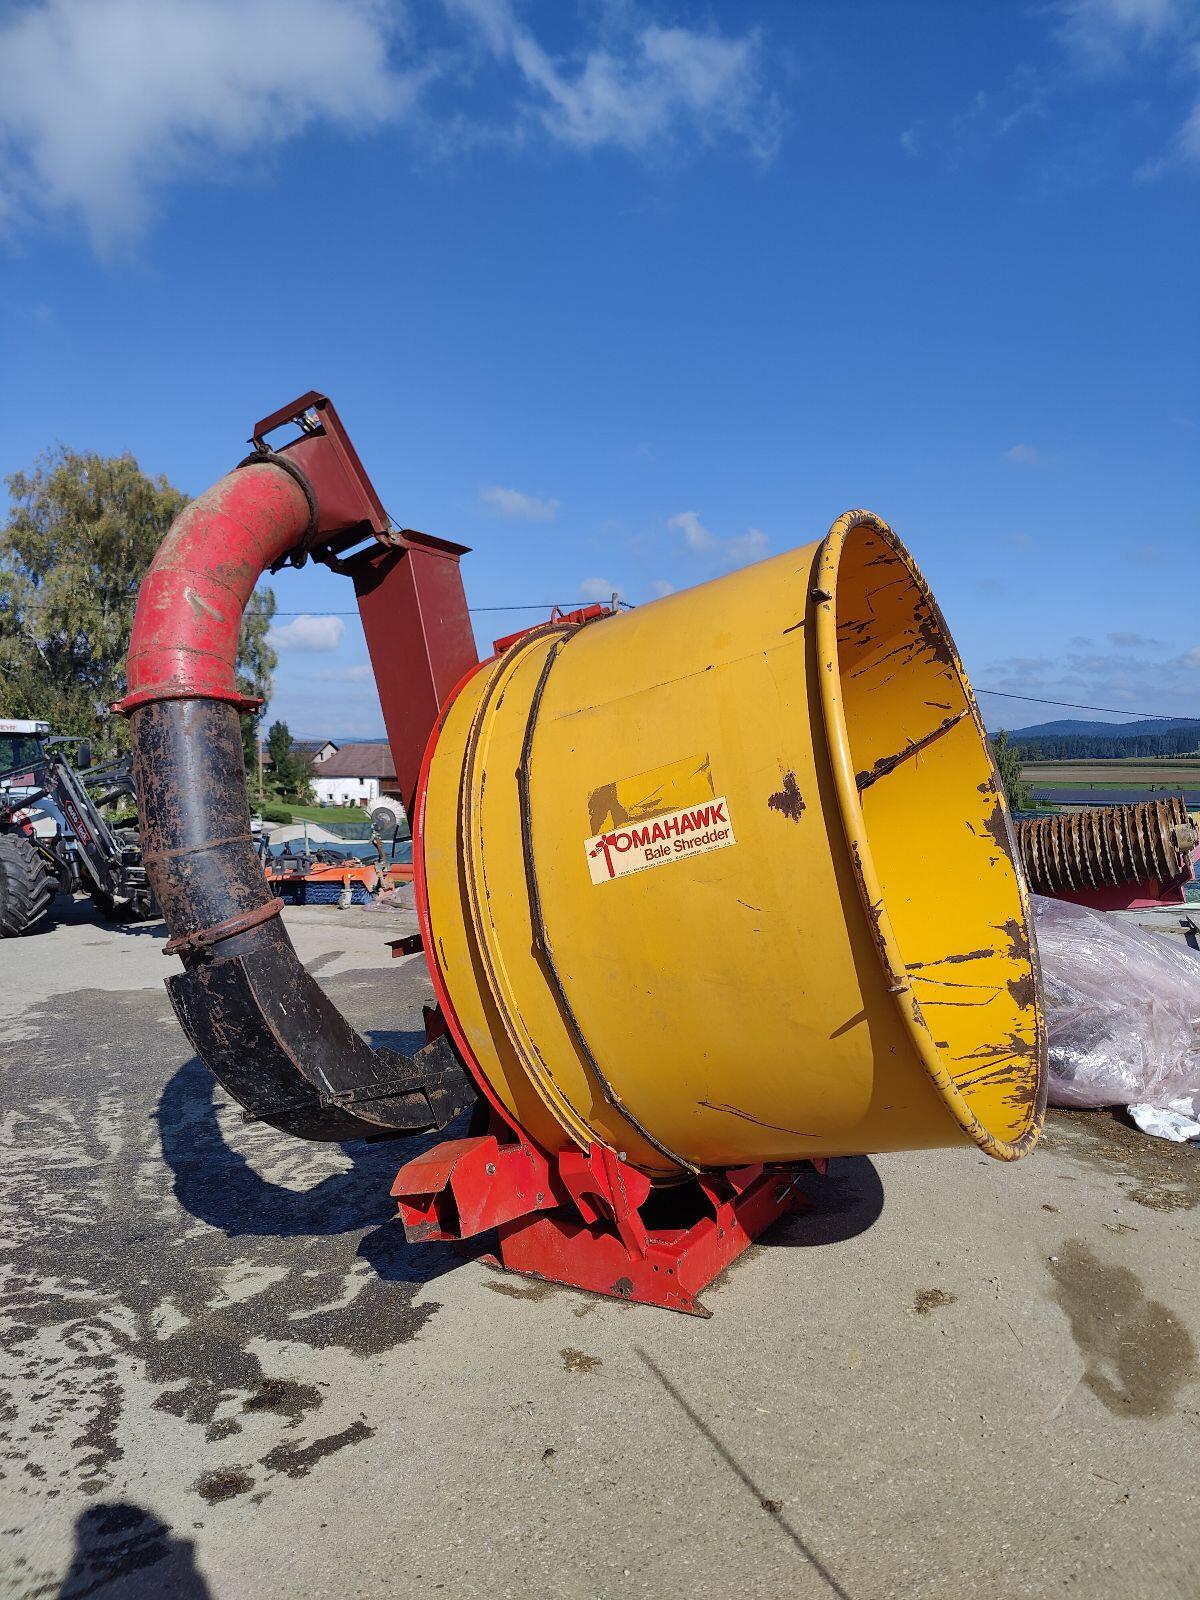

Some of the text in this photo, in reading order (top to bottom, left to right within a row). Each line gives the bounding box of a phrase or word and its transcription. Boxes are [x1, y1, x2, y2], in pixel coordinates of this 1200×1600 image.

[590, 802, 727, 877] TOMAHAWK
[644, 844, 671, 861] Bale
[674, 828, 729, 852] Shredder
